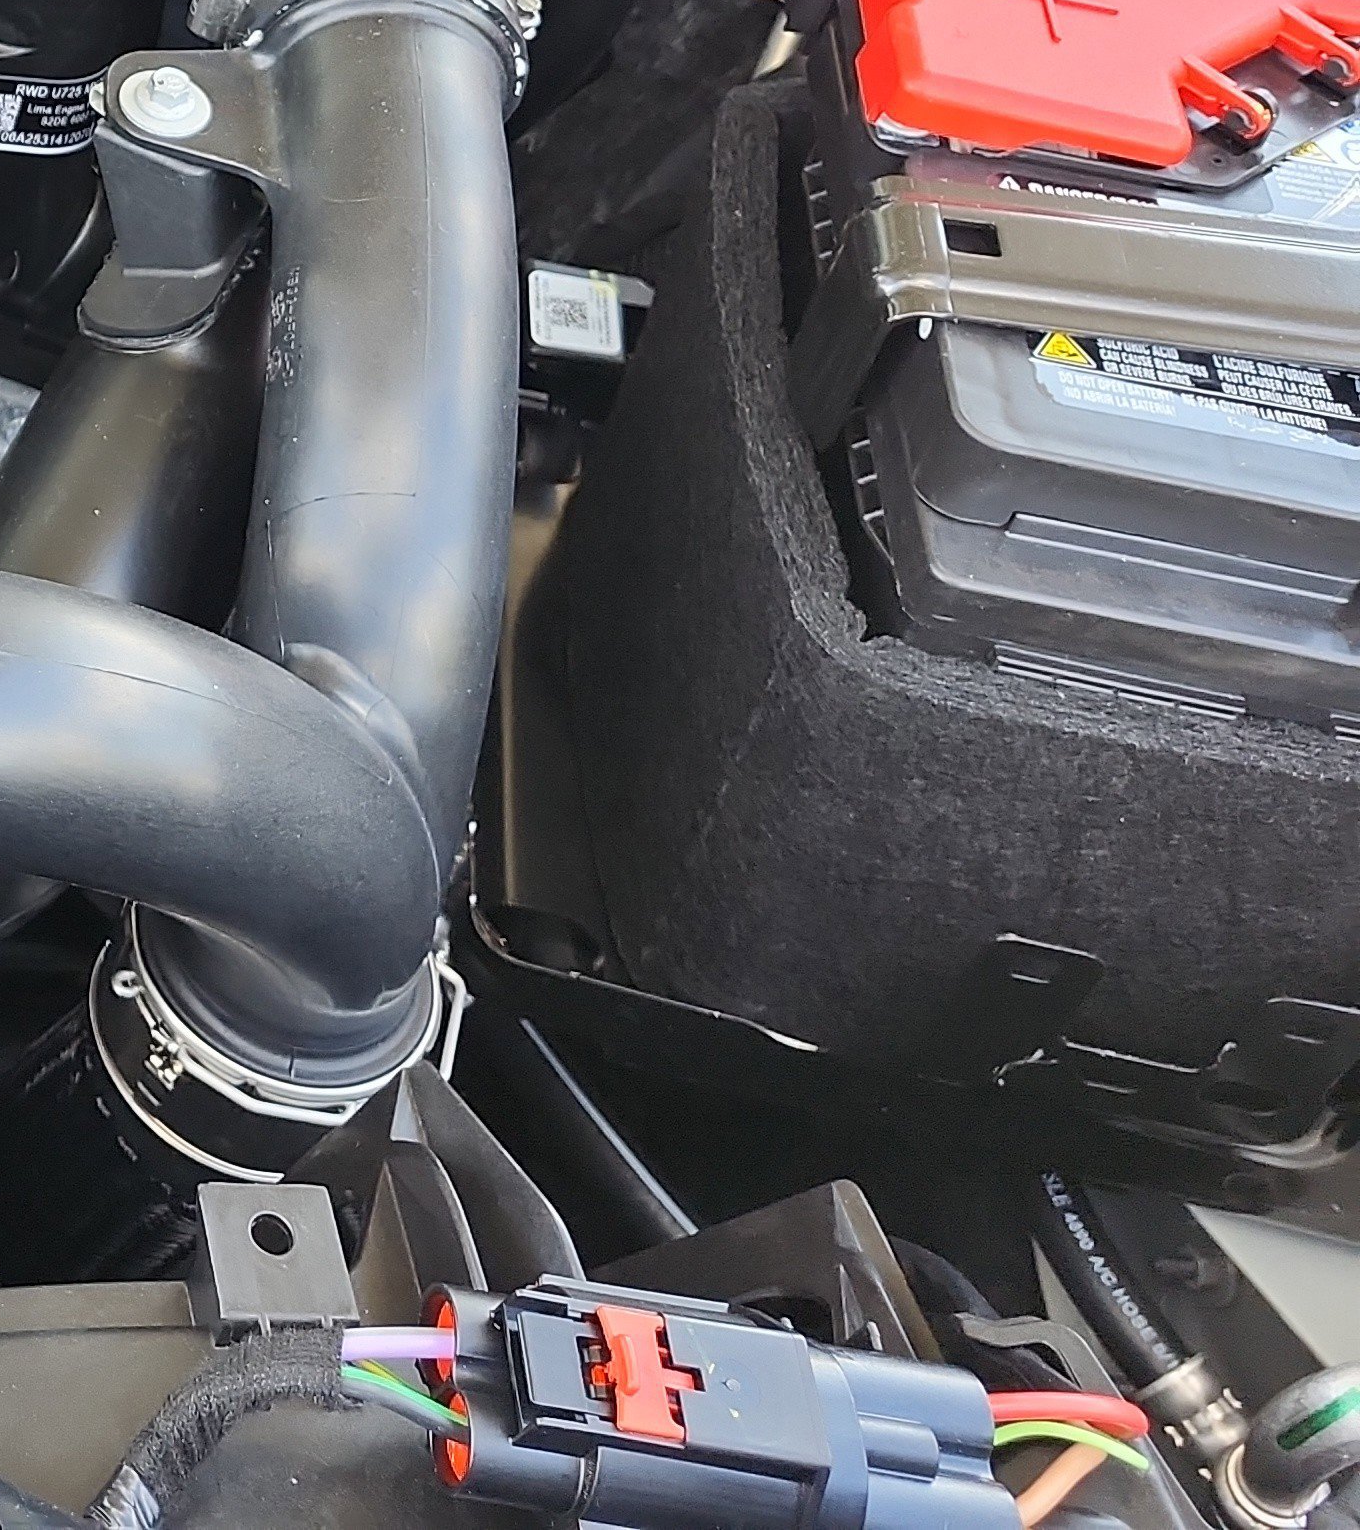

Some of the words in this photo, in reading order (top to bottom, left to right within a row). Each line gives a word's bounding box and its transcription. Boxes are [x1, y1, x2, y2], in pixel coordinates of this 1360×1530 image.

[15, 84, 48, 98] RWD
[51, 84, 84, 99] U725
[26, 102, 52, 115] Lima
[1098, 349, 1120, 362] CAN
[1121, 354, 1152, 368] CAUSE
[1154, 359, 1209, 378] BLINDNESS
[1102, 361, 1119, 373] OR
[1118, 364, 1154, 379] SEVERE
[1211, 354, 1256, 373] L'ACIDE
[1257, 362, 1328, 386] SULFURIQUE
[1076, 373, 1097, 389] NOT
[1099, 378, 1127, 392] OPEN
[1126, 384, 1175, 403] BATTERY!
[1216, 369, 1244, 384] PEUT
[1245, 375, 1284, 391] CAUSER
[1285, 381, 1299, 393] LA
[1082, 388, 1112, 407] ABRIR
[1221, 383, 1236, 394] OU
[1238, 387, 1258, 398] DES
[1311, 399, 1353, 416] GRAVES.
[1198, 397, 1218, 410] PAS
[1218, 400, 1258, 418] OUVRIR
[1259, 408, 1274, 421] LA
[1274, 411, 1329, 431] BATTERIE!
